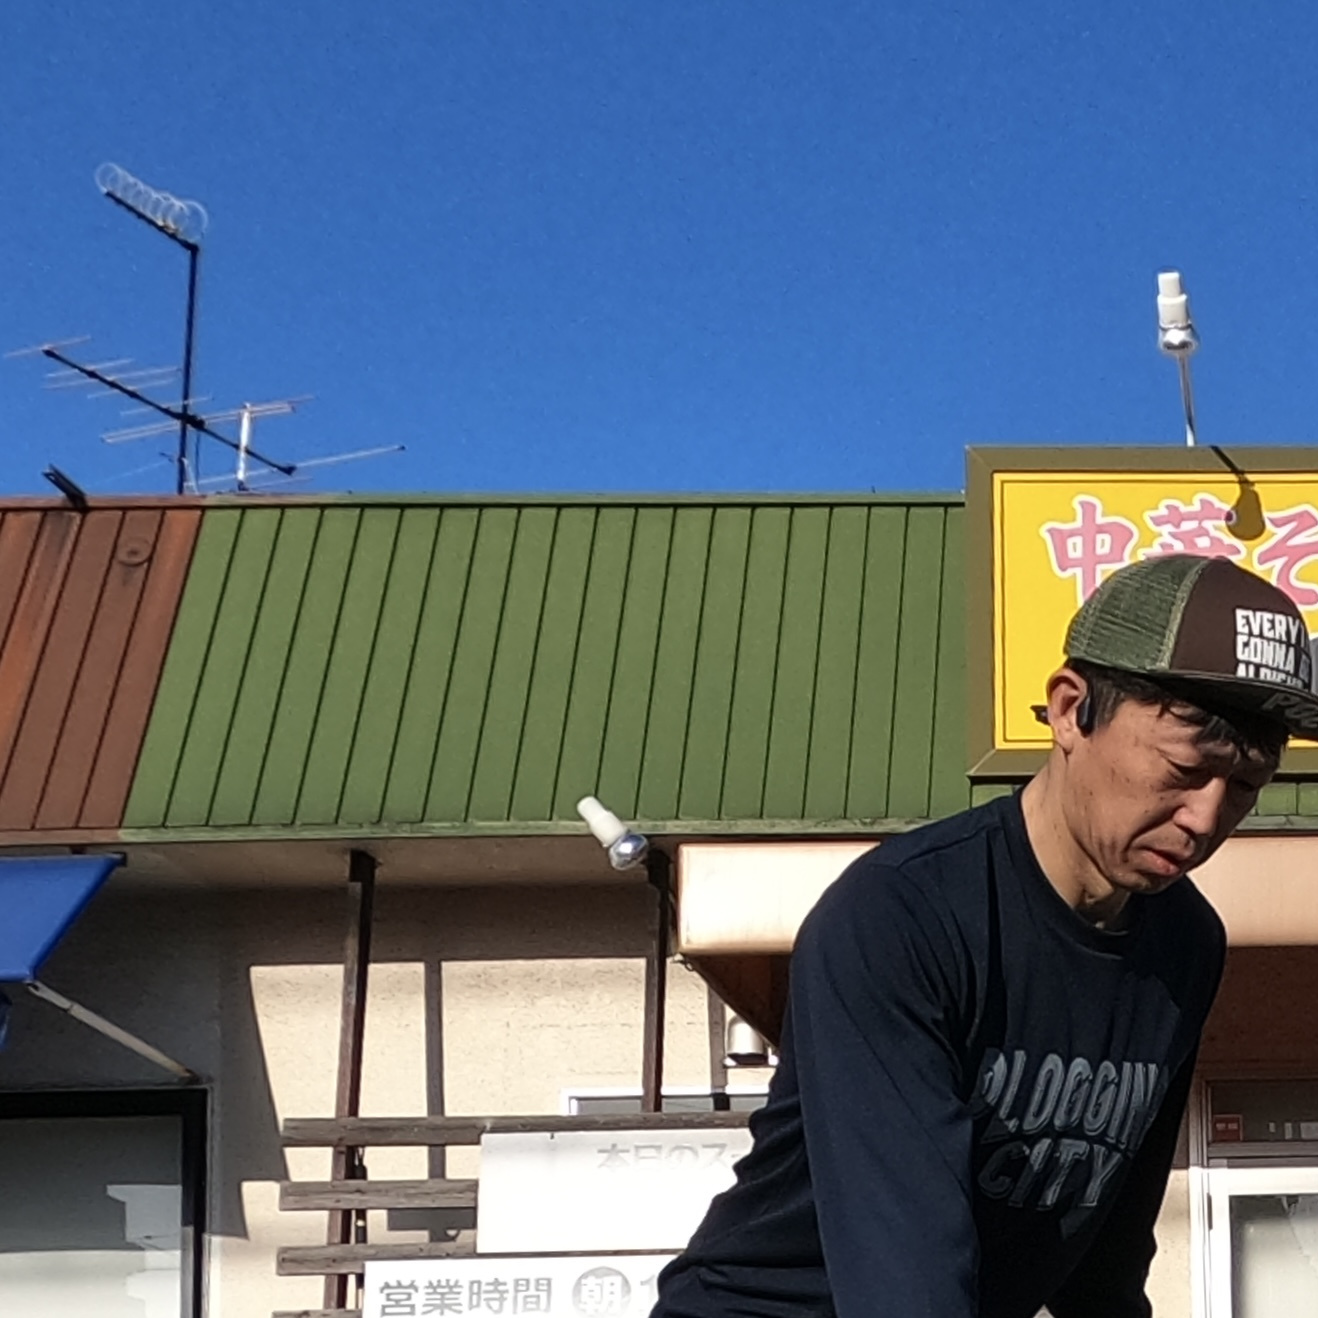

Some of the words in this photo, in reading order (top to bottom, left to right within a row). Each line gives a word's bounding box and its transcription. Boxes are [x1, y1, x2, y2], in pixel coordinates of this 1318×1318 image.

[1236, 634, 1296, 675] GONNA
[596, 1142, 742, 1170] 本日のス
[977, 1137, 1125, 1211] CITY
[378, 1277, 553, 1318] 営業時間
